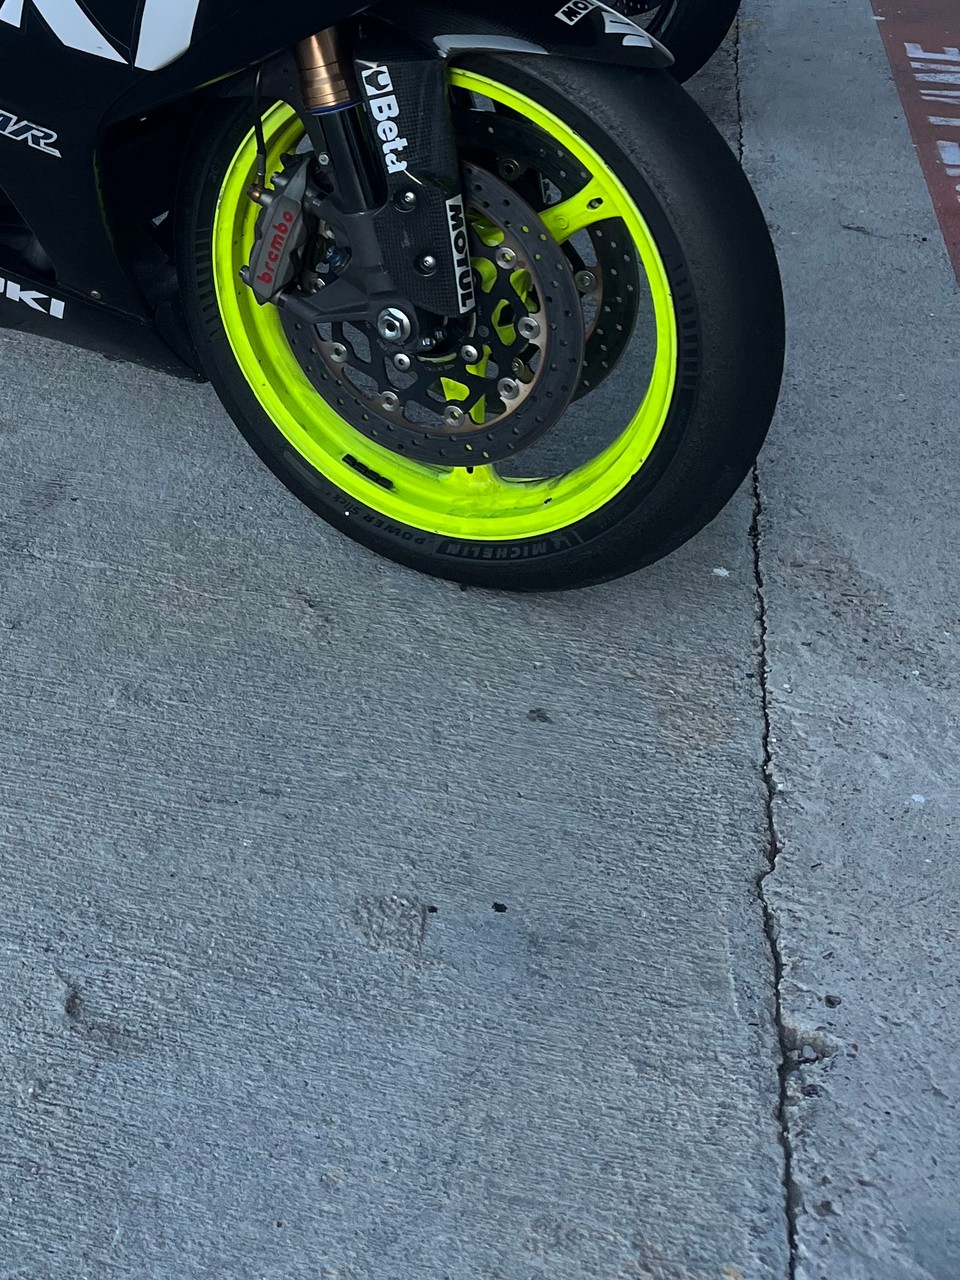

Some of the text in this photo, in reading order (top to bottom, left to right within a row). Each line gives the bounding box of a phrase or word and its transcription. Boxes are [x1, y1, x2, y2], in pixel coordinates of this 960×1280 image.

[369, 94, 409, 174] Beta
[256, 210, 294, 284] brembo
[448, 203, 474, 308] MOTUL
